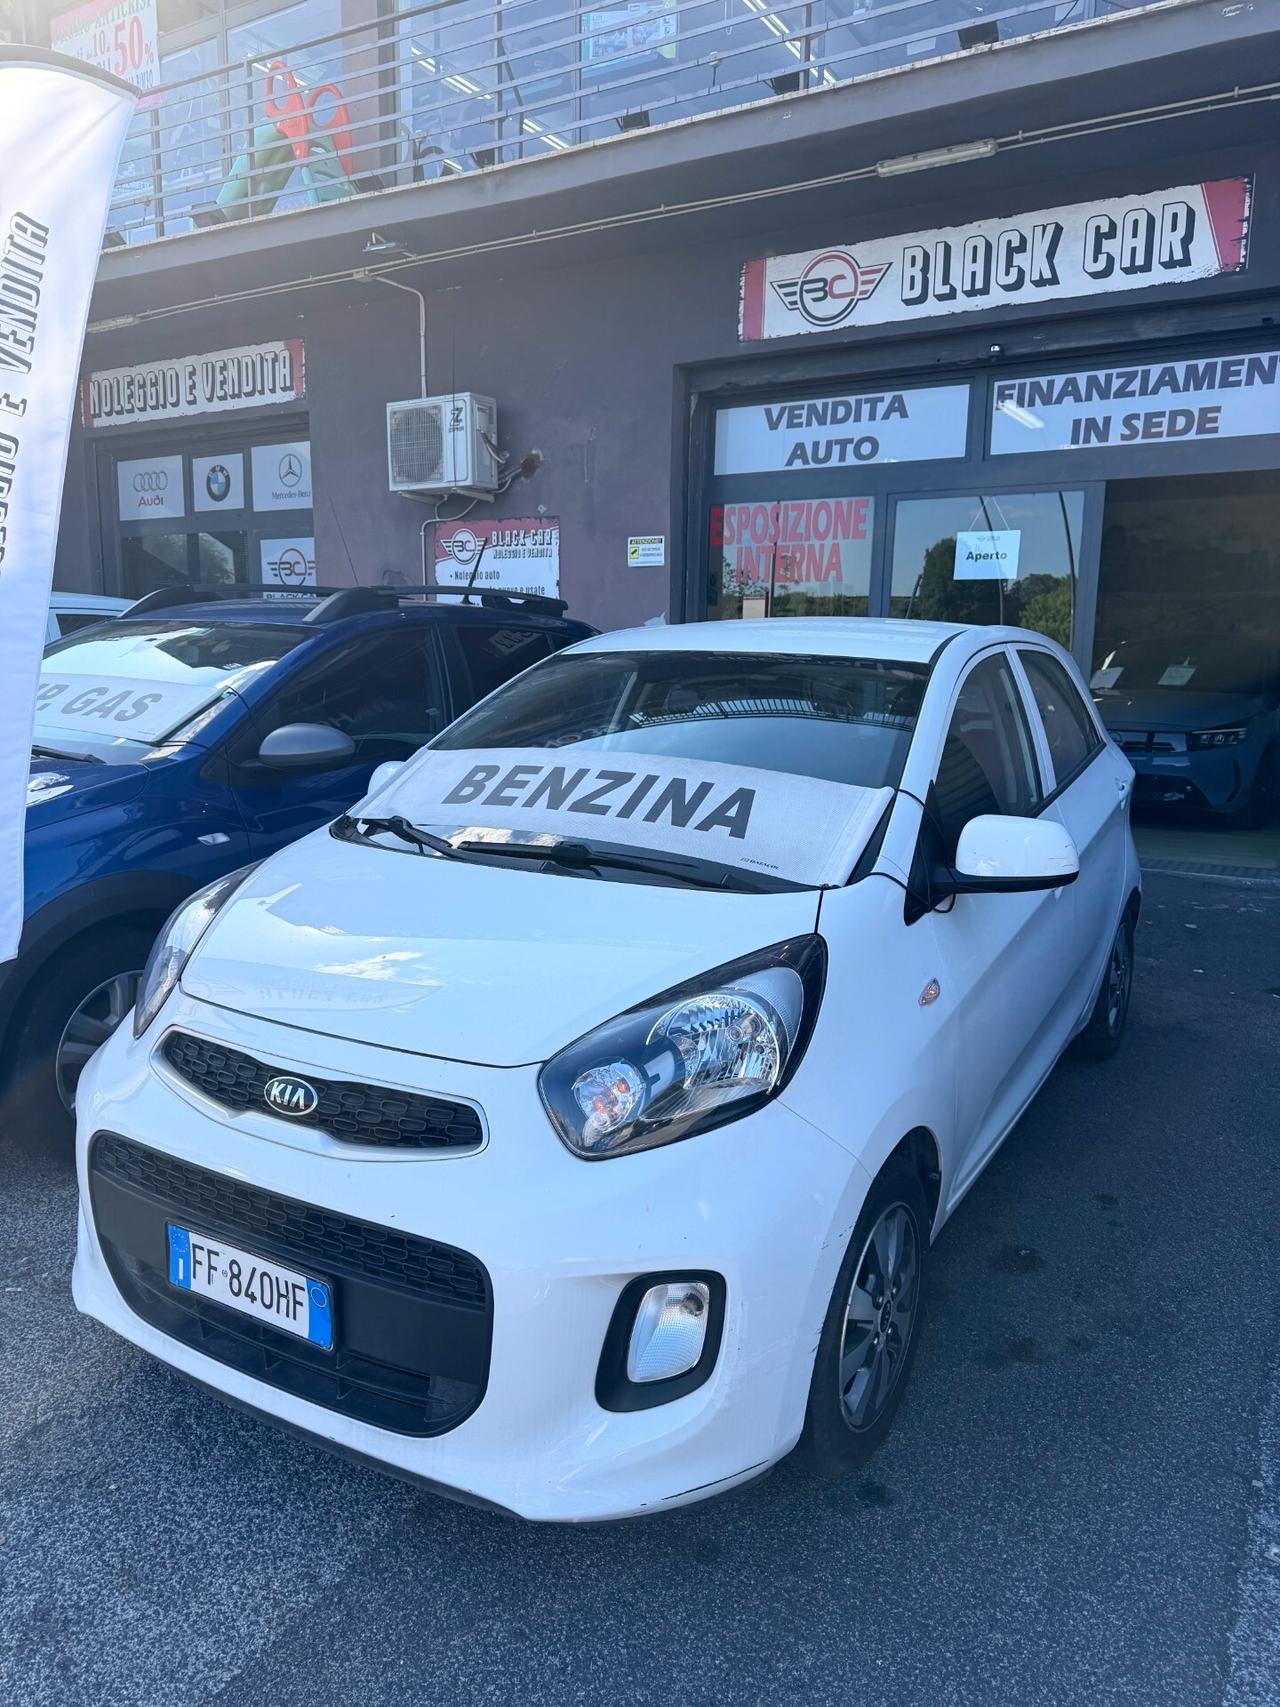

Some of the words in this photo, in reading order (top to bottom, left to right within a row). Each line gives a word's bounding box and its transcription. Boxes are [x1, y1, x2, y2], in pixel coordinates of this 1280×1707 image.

[900, 221, 1064, 306] BLACK
[1082, 200, 1197, 280] CAR
[0, 211, 50, 375] VENDITA
[89, 368, 180, 419] NOLEGGIO
[184, 364, 198, 406] E
[202, 349, 294, 403] VENDITA
[994, 355, 1280, 411] FINANZIAMEN
[763, 394, 910, 432] VENDITA
[1070, 415, 1112, 446] IN
[1120, 405, 1223, 442] SEDE
[785, 435, 880, 468] AUTO
[137, 495, 165, 508] Audi
[491, 530, 528, 547] BLACK
[530, 528, 553, 546] CAR
[709, 498, 870, 547] ESPOSIZIONE
[454, 570, 484, 581] Noleio
[484, 570, 500, 580] auto
[735, 542, 844, 585] INTERNA
[965, 551, 1008, 563] Aperto
[60, 686, 163, 722] GAS
[440, 764, 757, 840] BENZINA
[269, 1080, 305, 1110] KIA
[191, 1242, 220, 1286] FF
[228, 1258, 306, 1321] 840HF
